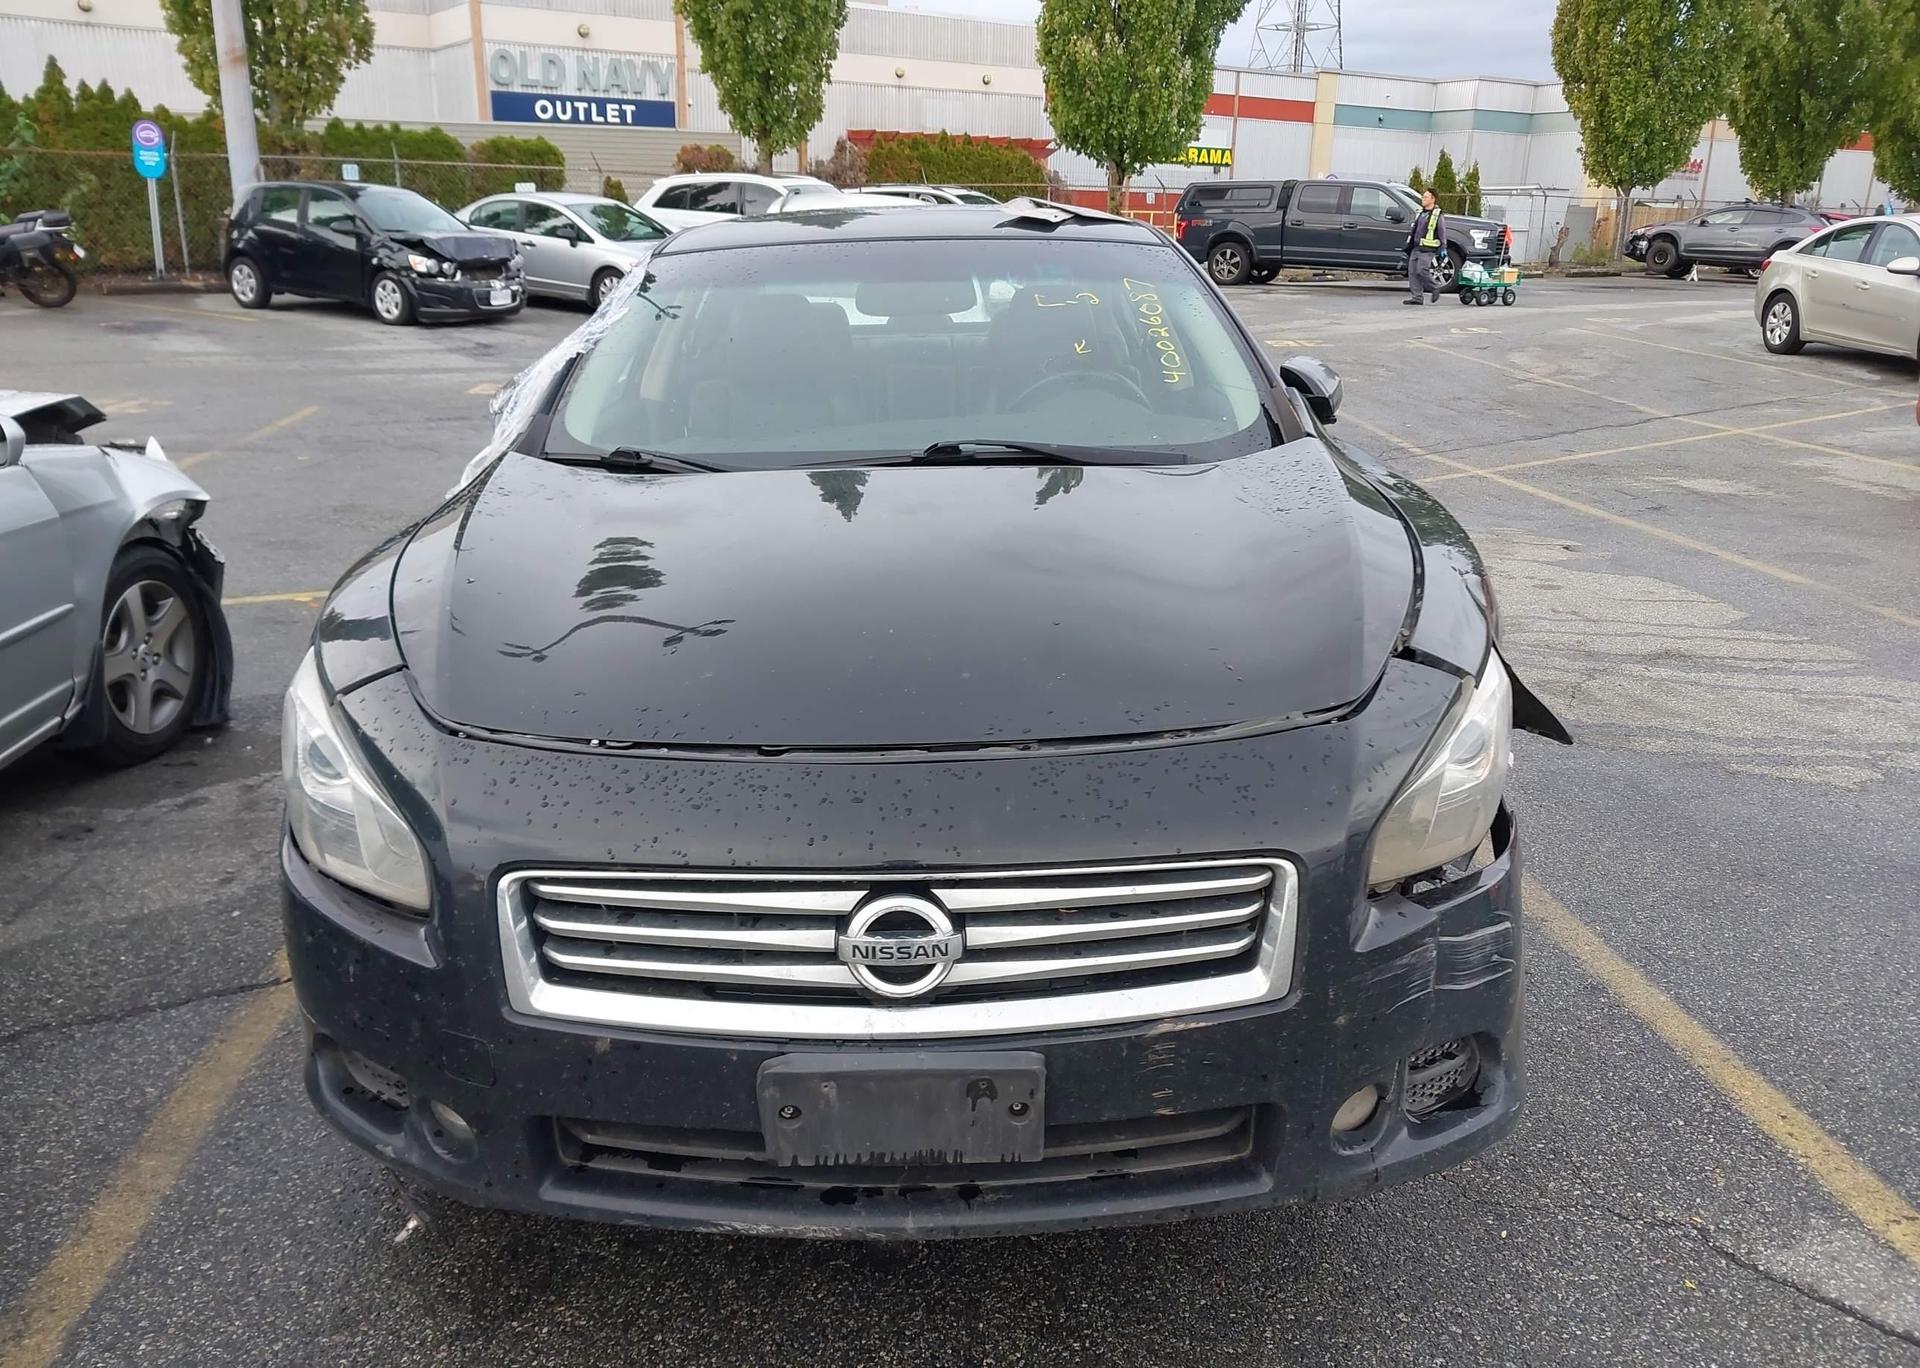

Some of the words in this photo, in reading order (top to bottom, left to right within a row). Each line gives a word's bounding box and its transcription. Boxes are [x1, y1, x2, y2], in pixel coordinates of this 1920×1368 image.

[490, 48, 566, 88] OLD
[576, 54, 675, 96] NAVY
[534, 99, 636, 124] OUTLET
[1123, 277, 1186, 383] 40026087
[852, 942, 949, 960] NISSAN
